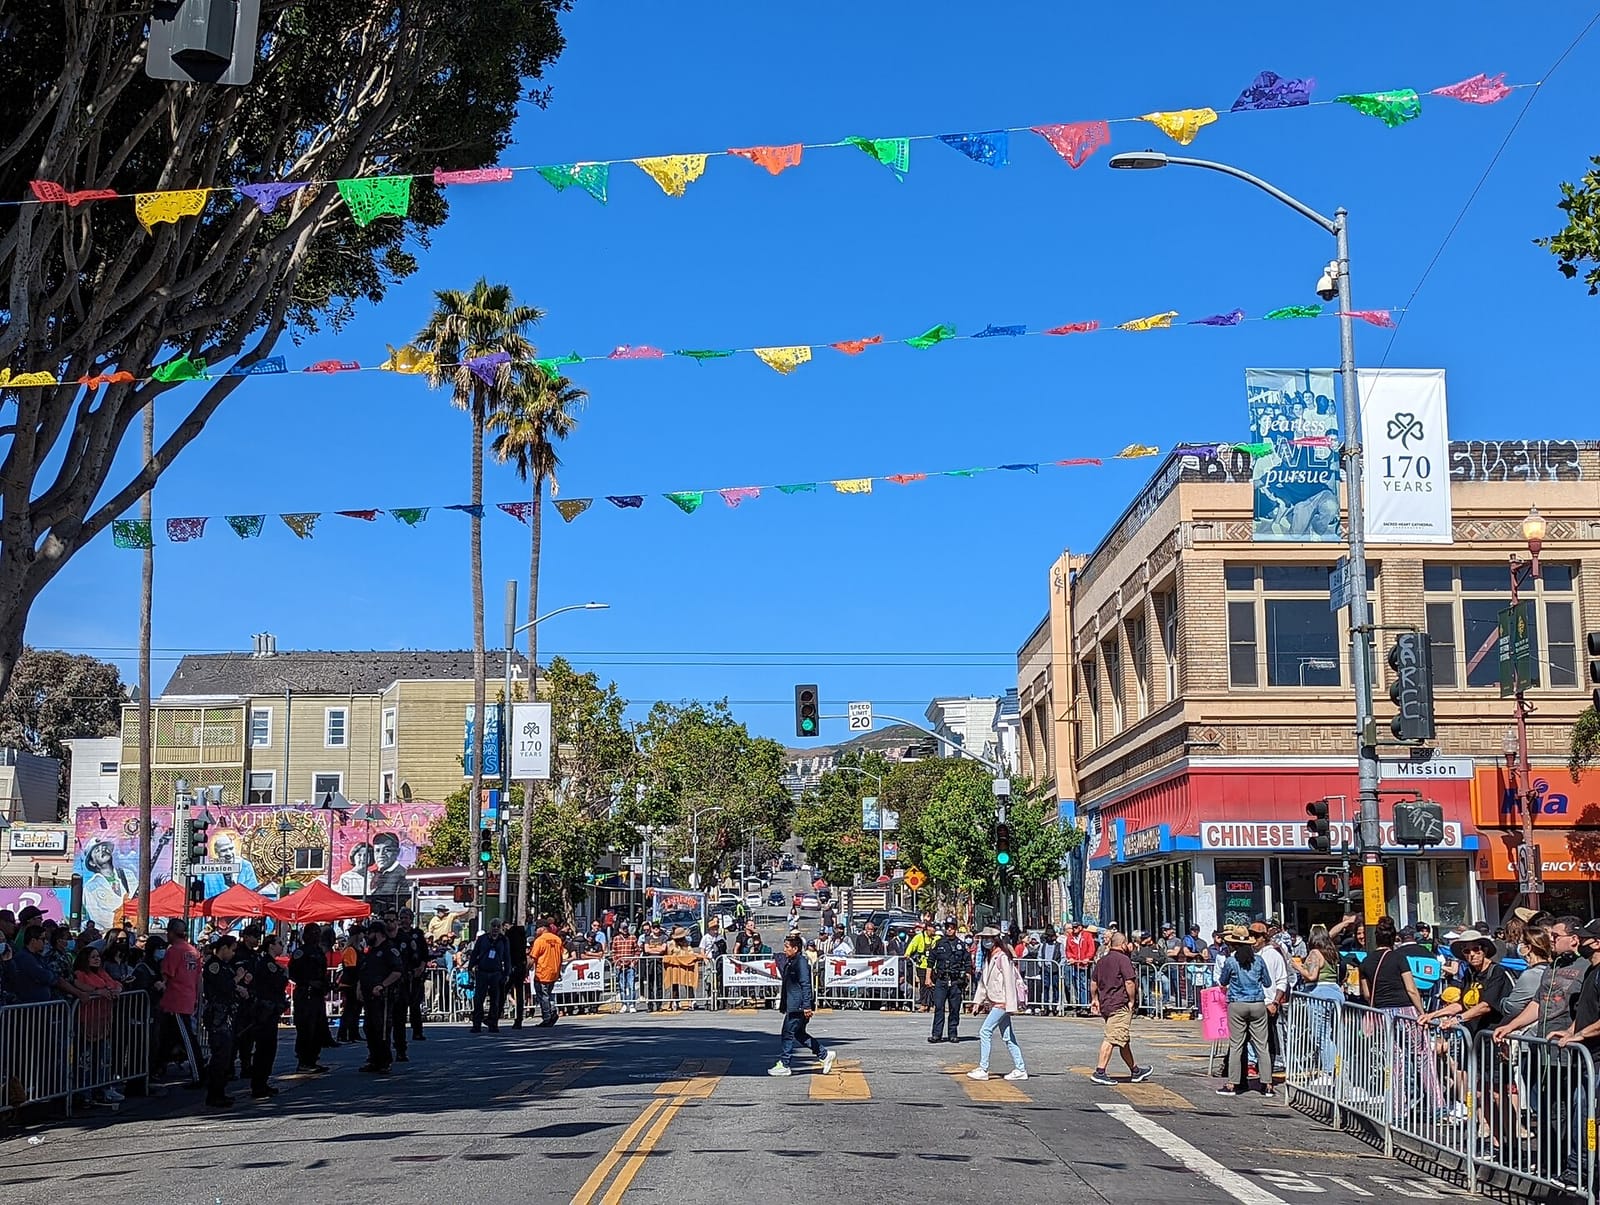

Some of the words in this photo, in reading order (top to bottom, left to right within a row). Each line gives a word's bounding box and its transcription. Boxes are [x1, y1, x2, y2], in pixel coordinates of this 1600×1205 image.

[1263, 414, 1326, 435] fearless
[1382, 455, 1431, 479] 170
[1264, 470, 1329, 487] pursue
[1383, 481, 1433, 492] YEARS
[852, 717, 870, 728] 20
[520, 741, 542, 752] 170
[1398, 763, 1457, 774] Mission
[1206, 825, 1294, 846] CHINESE
[15, 840, 60, 848] Garden
[201, 864, 232, 872] Mission
[587, 971, 601, 980] 48
[844, 968, 857, 977] 48
[881, 968, 895, 977] 48
